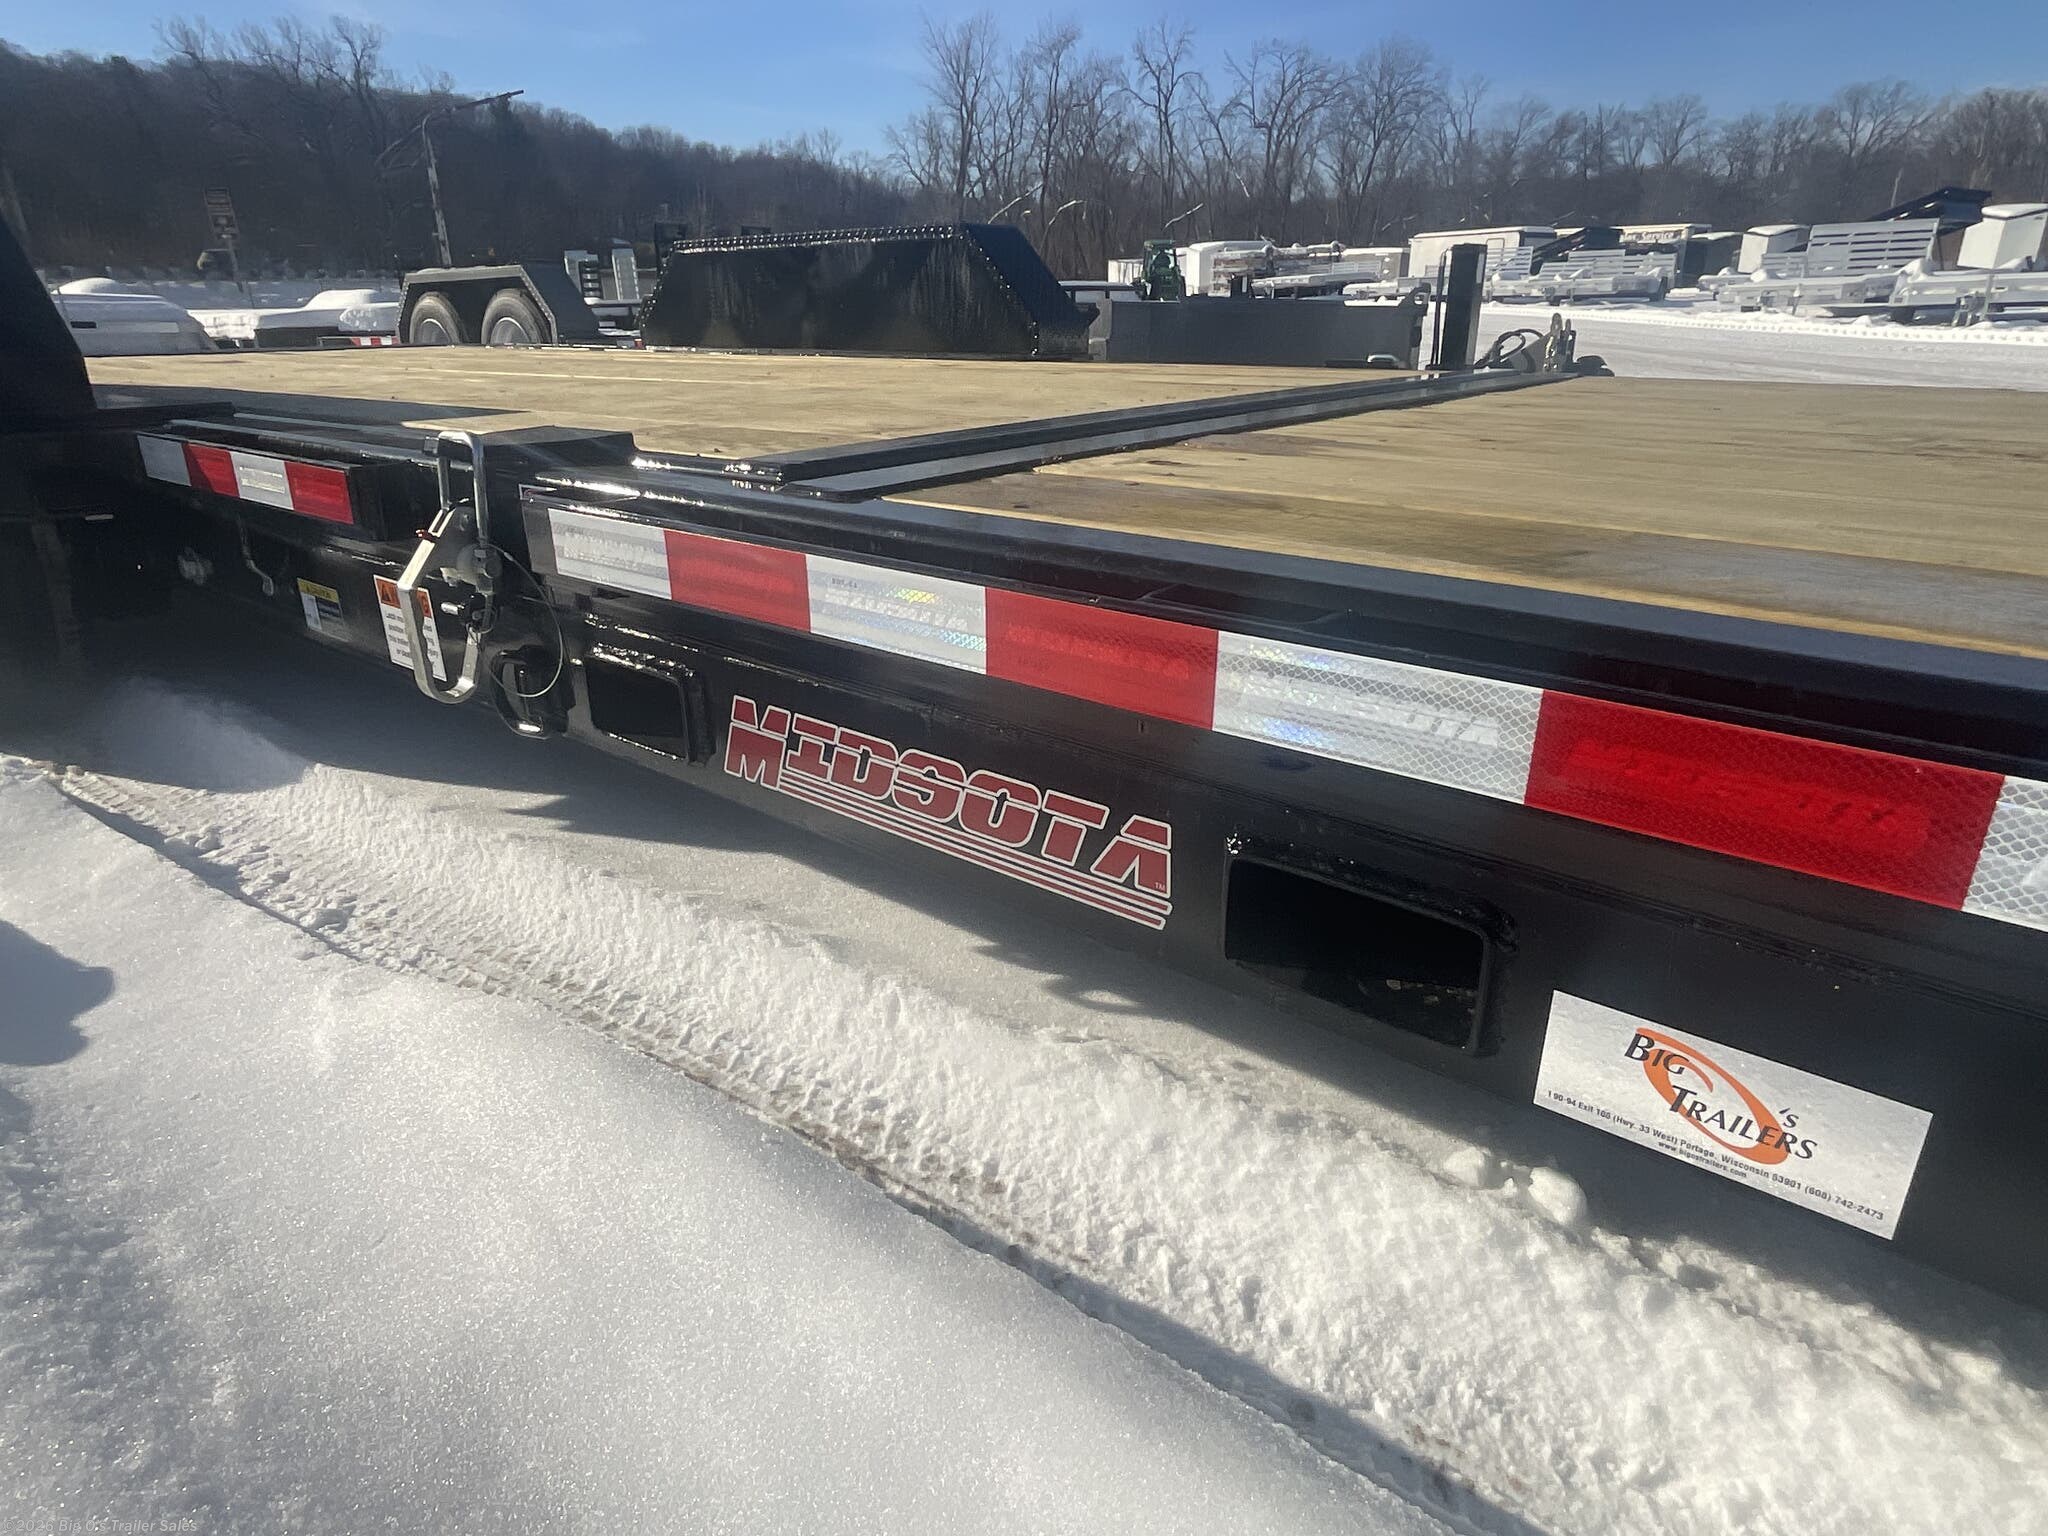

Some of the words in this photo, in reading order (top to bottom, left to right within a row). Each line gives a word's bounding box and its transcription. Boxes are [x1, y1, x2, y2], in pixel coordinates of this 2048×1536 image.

[724, 695, 1172, 900] MIDSOTA
[1624, 1034, 1690, 1074] BIG
[1578, 1101, 1594, 1113] Exit
[1639, 1124, 1651, 1134] 33
[1652, 1128, 1679, 1145] West)
[1720, 1154, 1770, 1178] Wisconsin
[1771, 1173, 1802, 1191] 53901
[1804, 1183, 1832, 1202] (608)
[1834, 1195, 1885, 1221] 742-2473
[1669, 1085, 1818, 1160] TRAILERS
